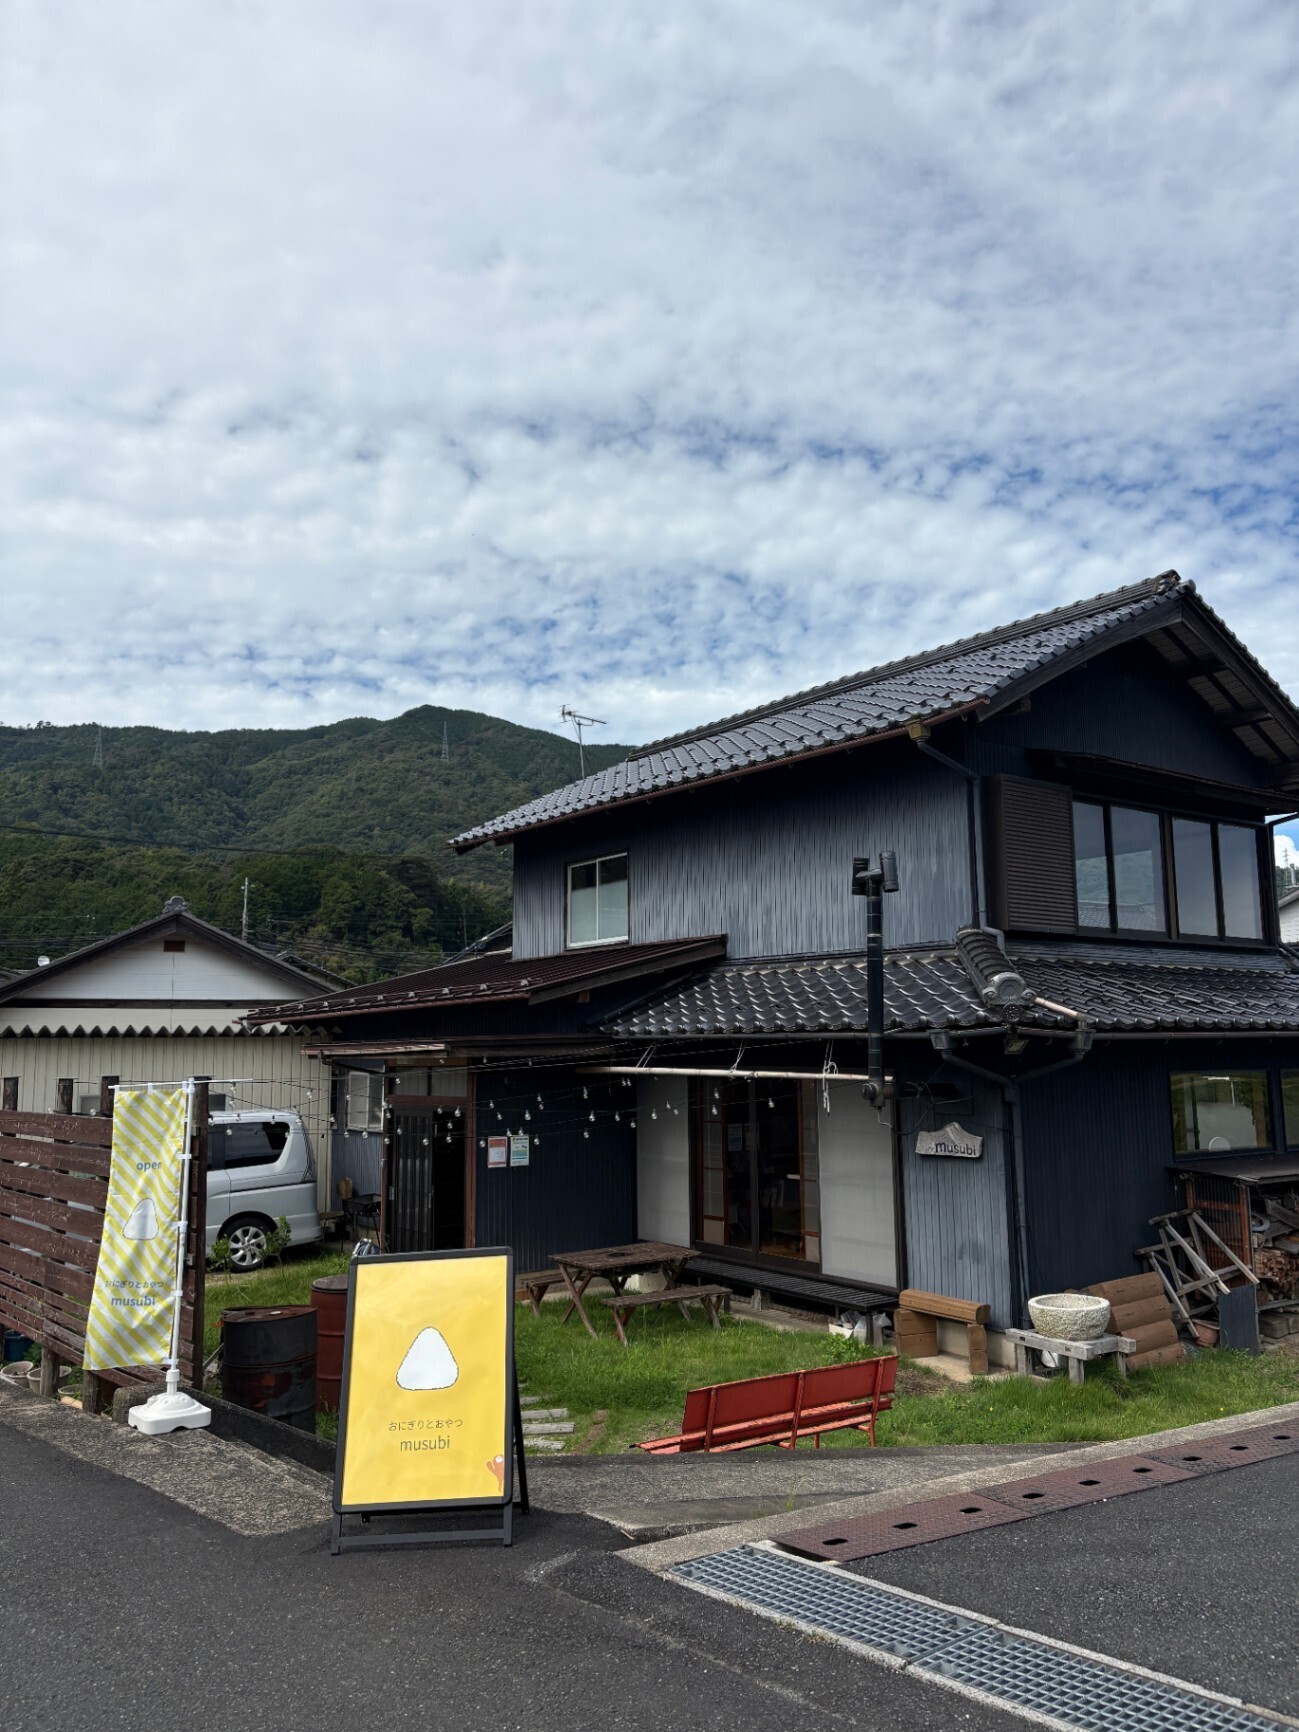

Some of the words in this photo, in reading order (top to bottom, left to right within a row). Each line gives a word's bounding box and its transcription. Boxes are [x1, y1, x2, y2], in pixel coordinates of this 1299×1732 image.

[935, 1142, 976, 1156] musubi
[105, 1280, 164, 1288] おにぎりとおやつ
[111, 1295, 156, 1306] musubi
[388, 1419, 463, 1431] おにぎりとおやつ
[400, 1435, 450, 1452] musubi
